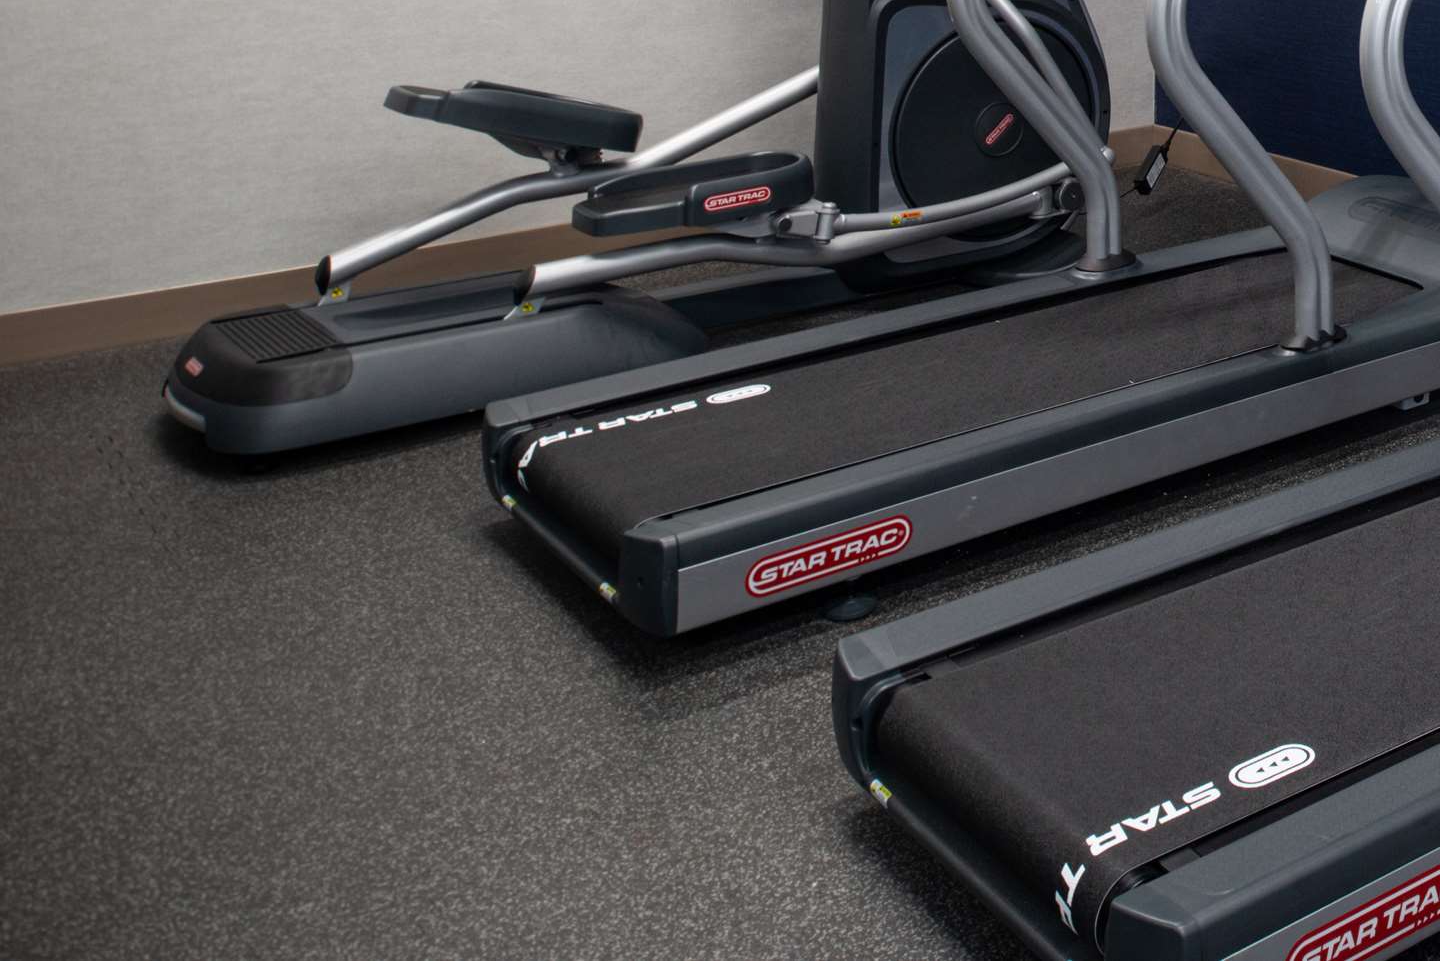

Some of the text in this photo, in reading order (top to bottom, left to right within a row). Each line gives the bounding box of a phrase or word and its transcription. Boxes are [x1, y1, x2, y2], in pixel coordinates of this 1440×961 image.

[707, 190, 766, 207] STAR TRAC
[598, 400, 698, 430] STAR
[760, 528, 898, 580] STAR TRAC
[1086, 781, 1222, 856] STAR
